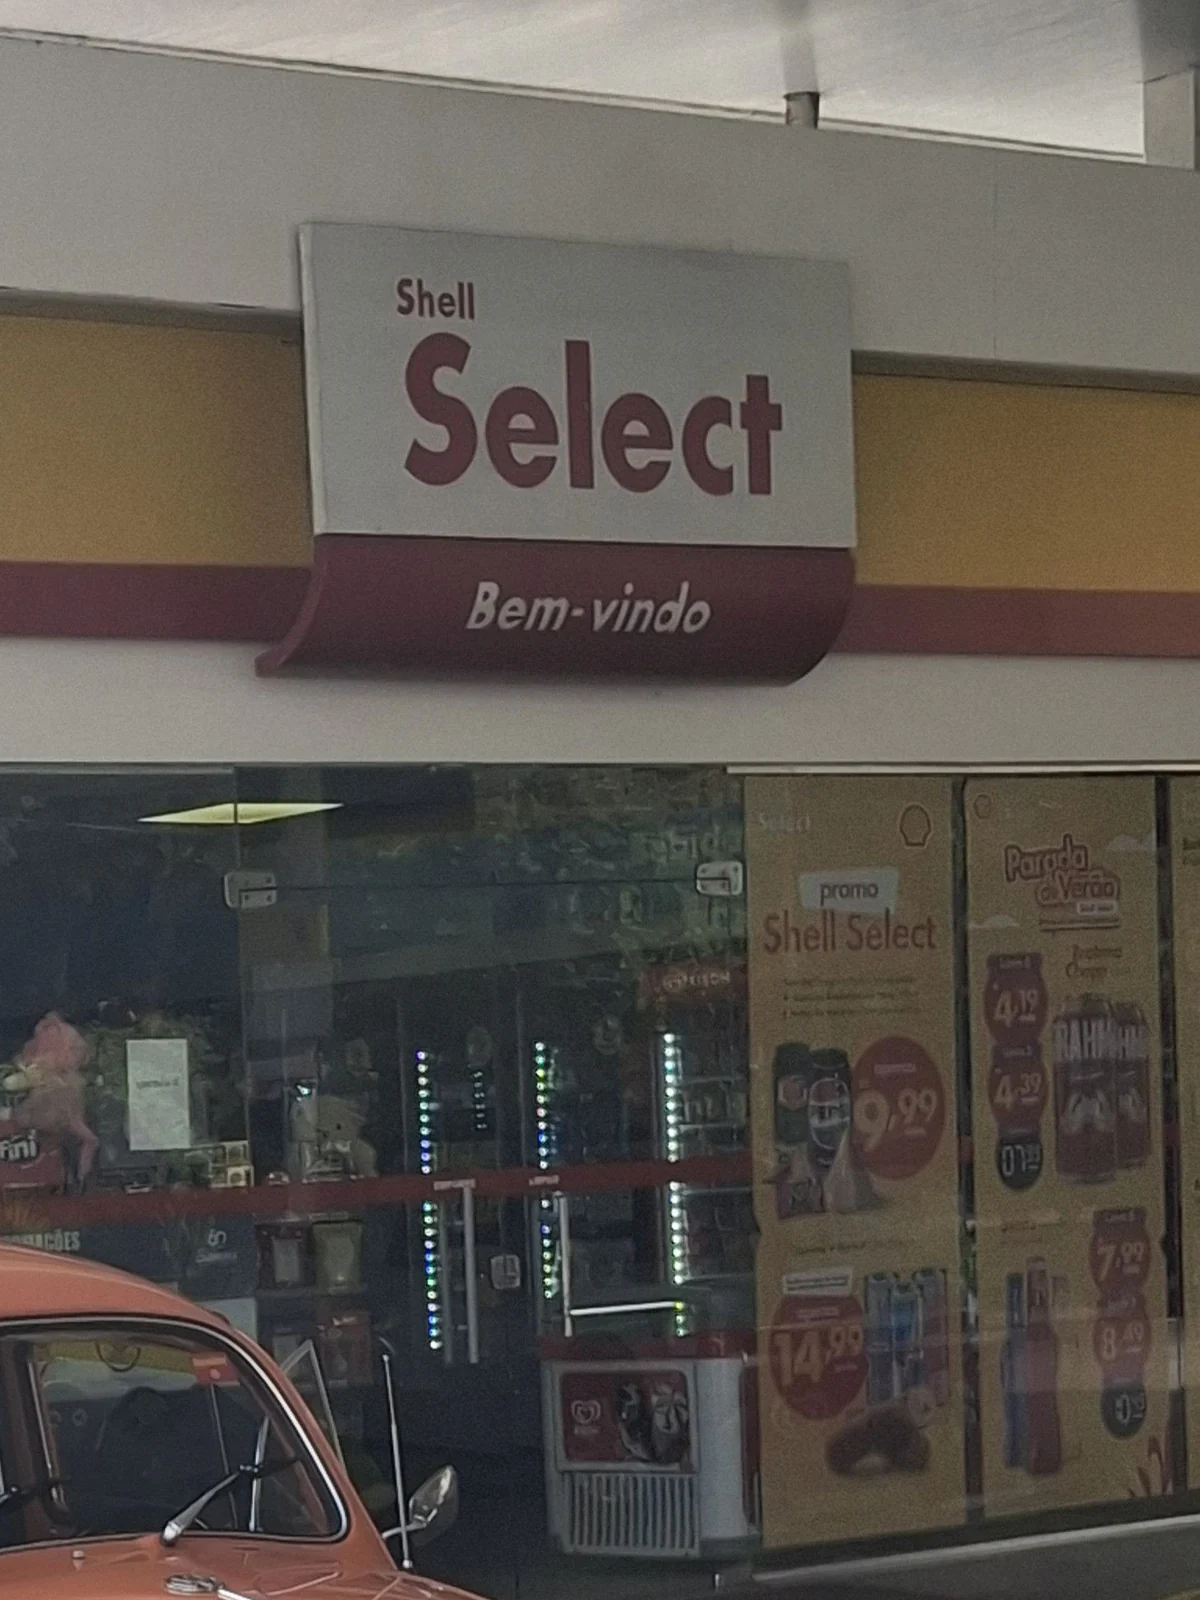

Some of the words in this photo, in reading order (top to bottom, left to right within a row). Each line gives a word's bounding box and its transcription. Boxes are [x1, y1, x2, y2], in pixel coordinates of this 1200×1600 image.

[396, 278, 476, 320] Shell
[403, 331, 783, 496] Select
[465, 580, 712, 635] Bem-vindo
[1005, 835, 1087, 881] Parada
[819, 882, 879, 907] promo
[763, 909, 836, 954] Shell
[846, 907, 938, 951] Select
[853, 1087, 938, 1152] 9,99
